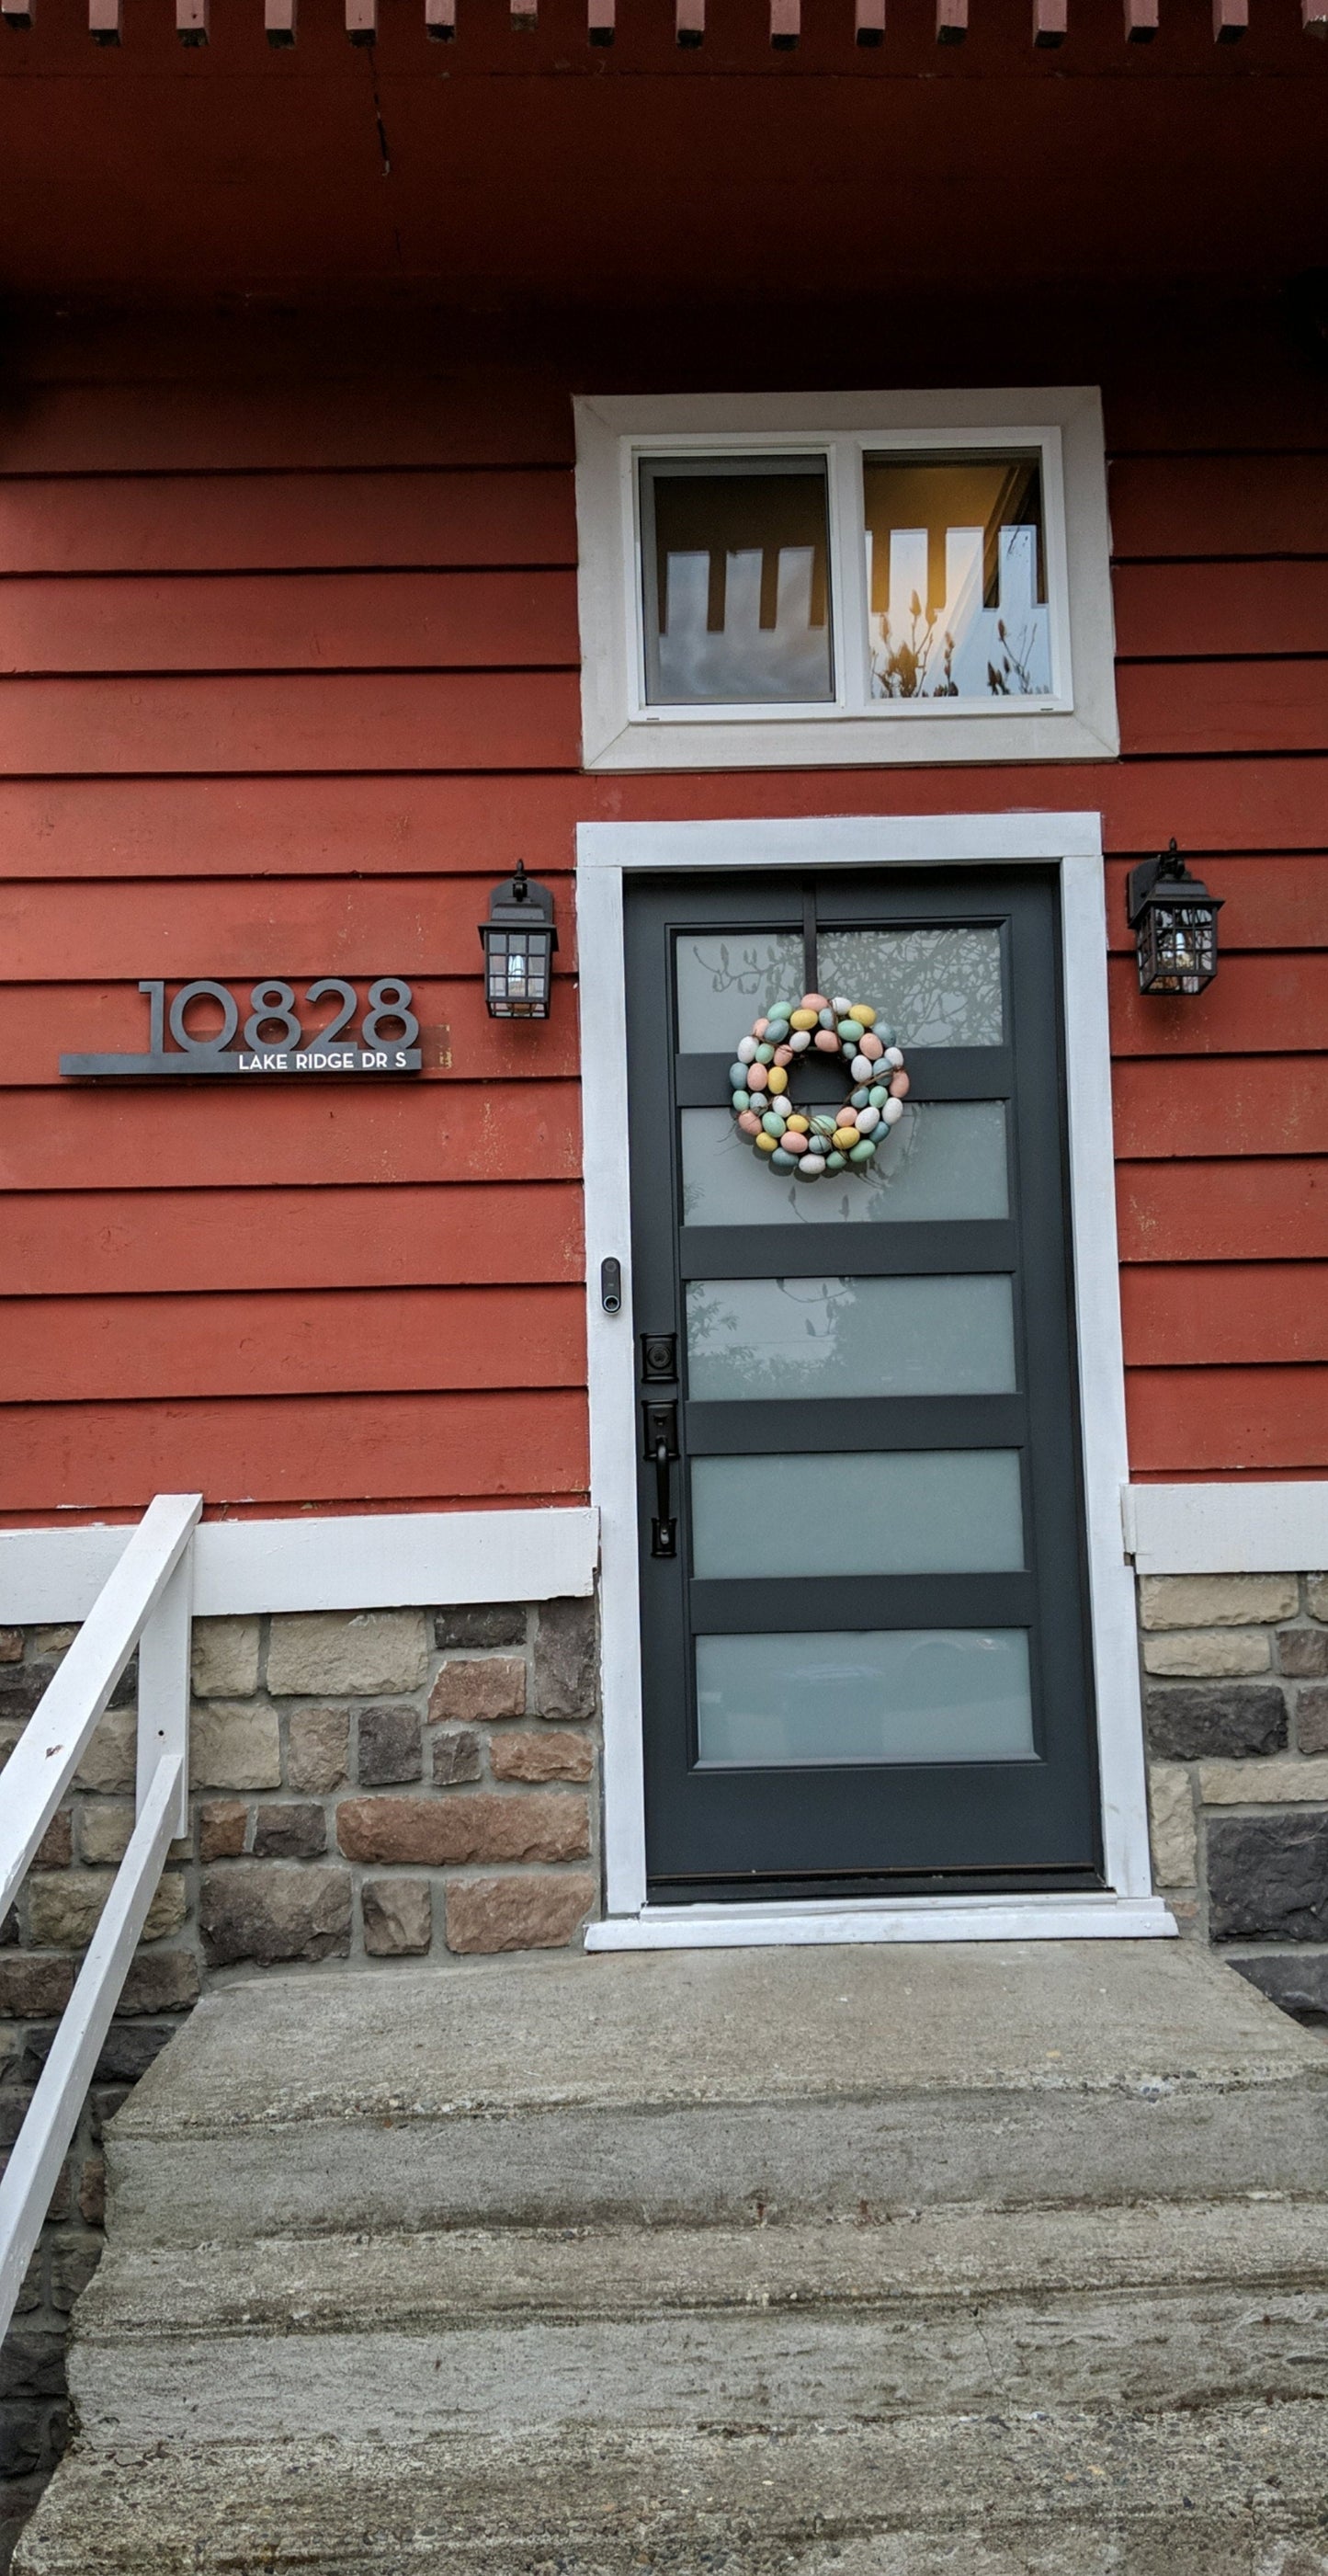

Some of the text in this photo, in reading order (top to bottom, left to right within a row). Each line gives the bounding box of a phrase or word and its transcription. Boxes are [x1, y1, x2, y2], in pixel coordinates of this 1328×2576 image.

[138, 978, 419, 1053] 10828
[238, 1052, 407, 1070] LAKE RIDGE DR S
